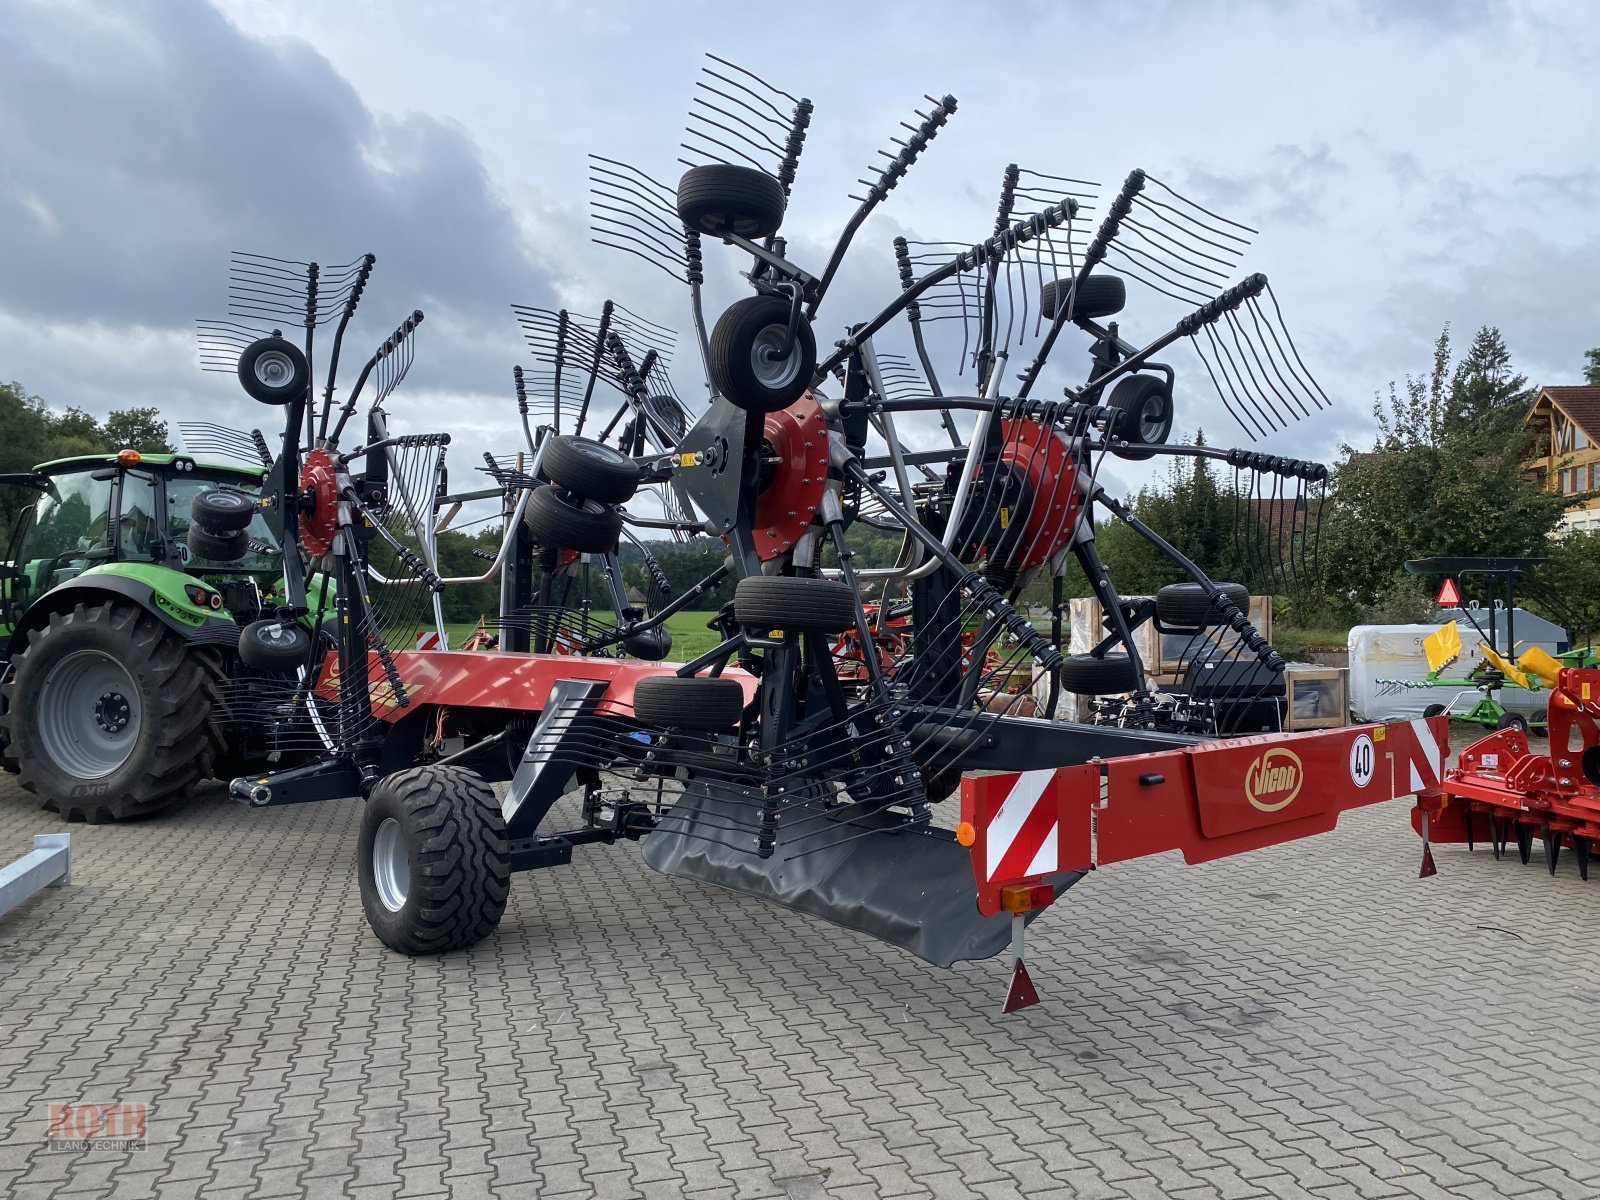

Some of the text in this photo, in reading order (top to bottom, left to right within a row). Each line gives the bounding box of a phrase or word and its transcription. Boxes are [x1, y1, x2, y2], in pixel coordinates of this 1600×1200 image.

[1254, 760, 1297, 796] Vicon
[1355, 743, 1370, 778] 40
[71, 784, 107, 798] BKT
